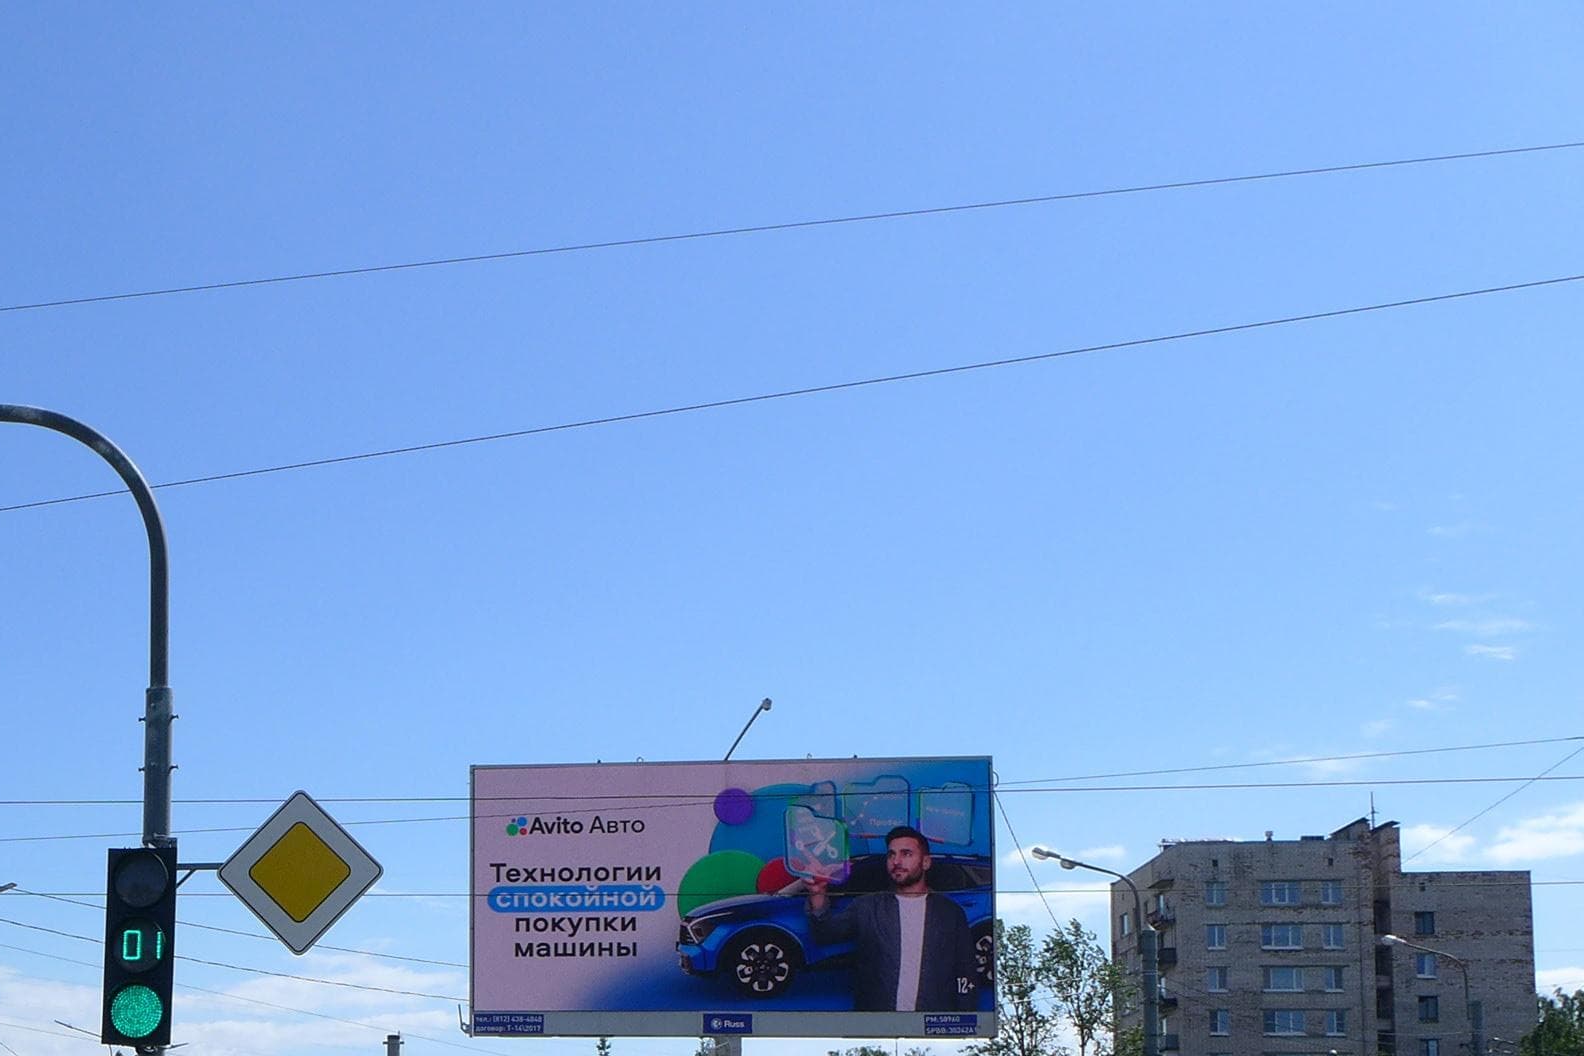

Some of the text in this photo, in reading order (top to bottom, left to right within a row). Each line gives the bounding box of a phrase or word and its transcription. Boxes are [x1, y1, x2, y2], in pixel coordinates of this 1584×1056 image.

[529, 816, 645, 834] Avito Авто
[489, 863, 661, 883] Технологии
[496, 885, 656, 908] спокойной
[515, 916, 637, 937] покупки
[123, 930, 162, 960] 01
[515, 942, 637, 957] машины
[957, 977, 975, 993] 12+
[724, 1020, 745, 1028] Russ
